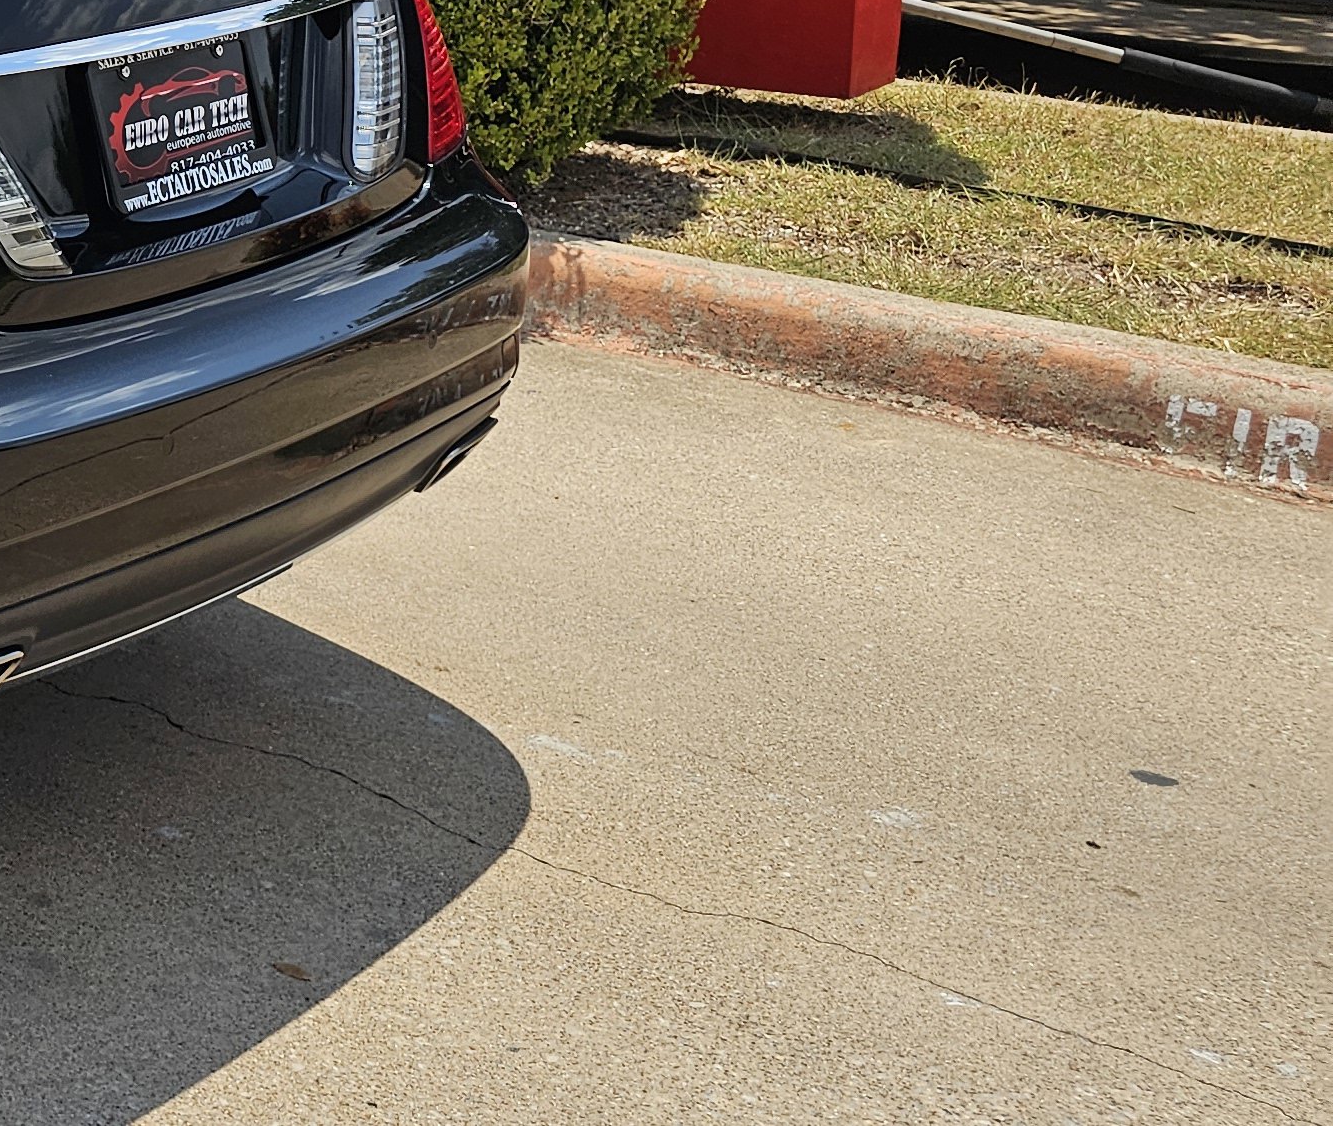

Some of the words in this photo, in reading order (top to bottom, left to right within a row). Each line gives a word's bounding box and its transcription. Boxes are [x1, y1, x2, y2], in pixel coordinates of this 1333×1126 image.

[97, 56, 126, 70] SALES
[124, 114, 169, 152] EURO
[174, 105, 206, 137] CAR
[209, 93, 249, 128] TECH
[166, 132, 206, 151] european
[206, 120, 252, 140] automotive
[170, 139, 256, 172] 817-404-4033
[124, 153, 274, 212] www.ECTAUTOSALES.com
